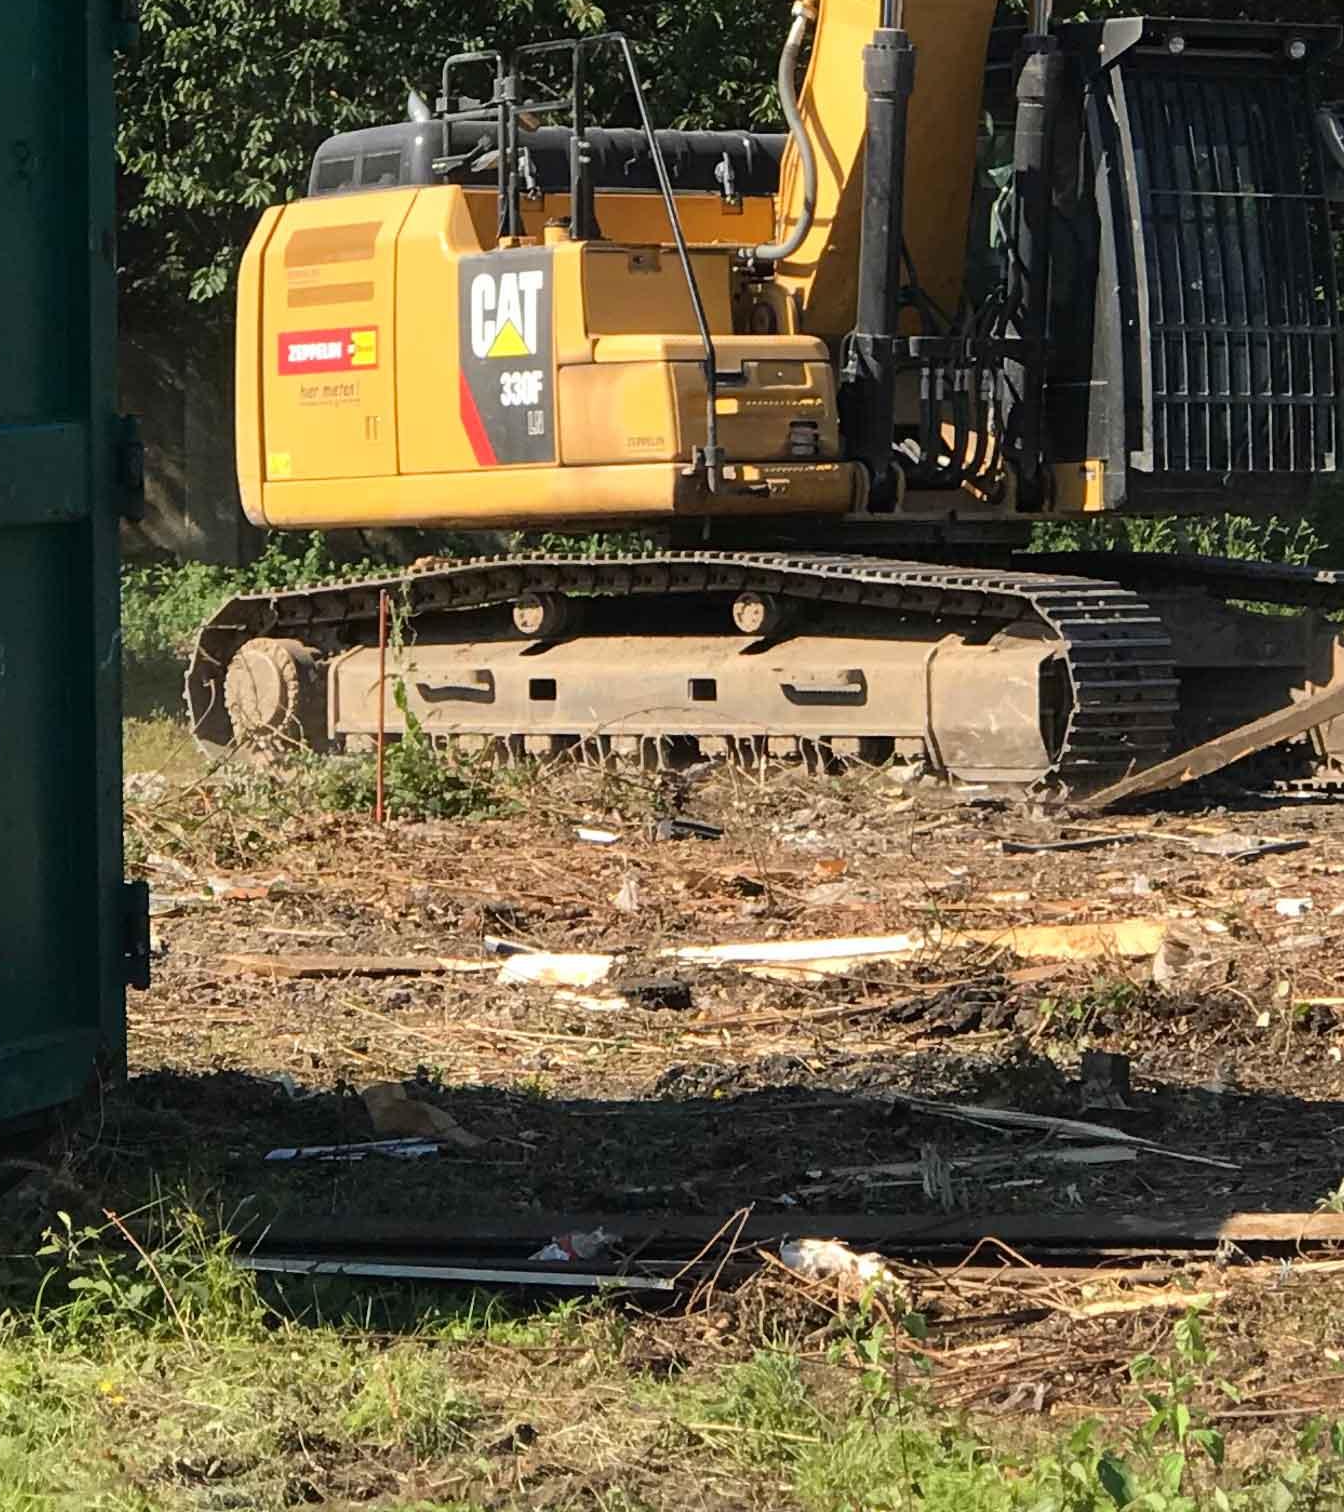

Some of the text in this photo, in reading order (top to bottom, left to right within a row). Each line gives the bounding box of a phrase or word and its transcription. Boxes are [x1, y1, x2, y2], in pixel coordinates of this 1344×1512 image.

[471, 270, 543, 359] CAT
[287, 342, 343, 363] ZEPPELIN
[500, 370, 543, 406] 330F
